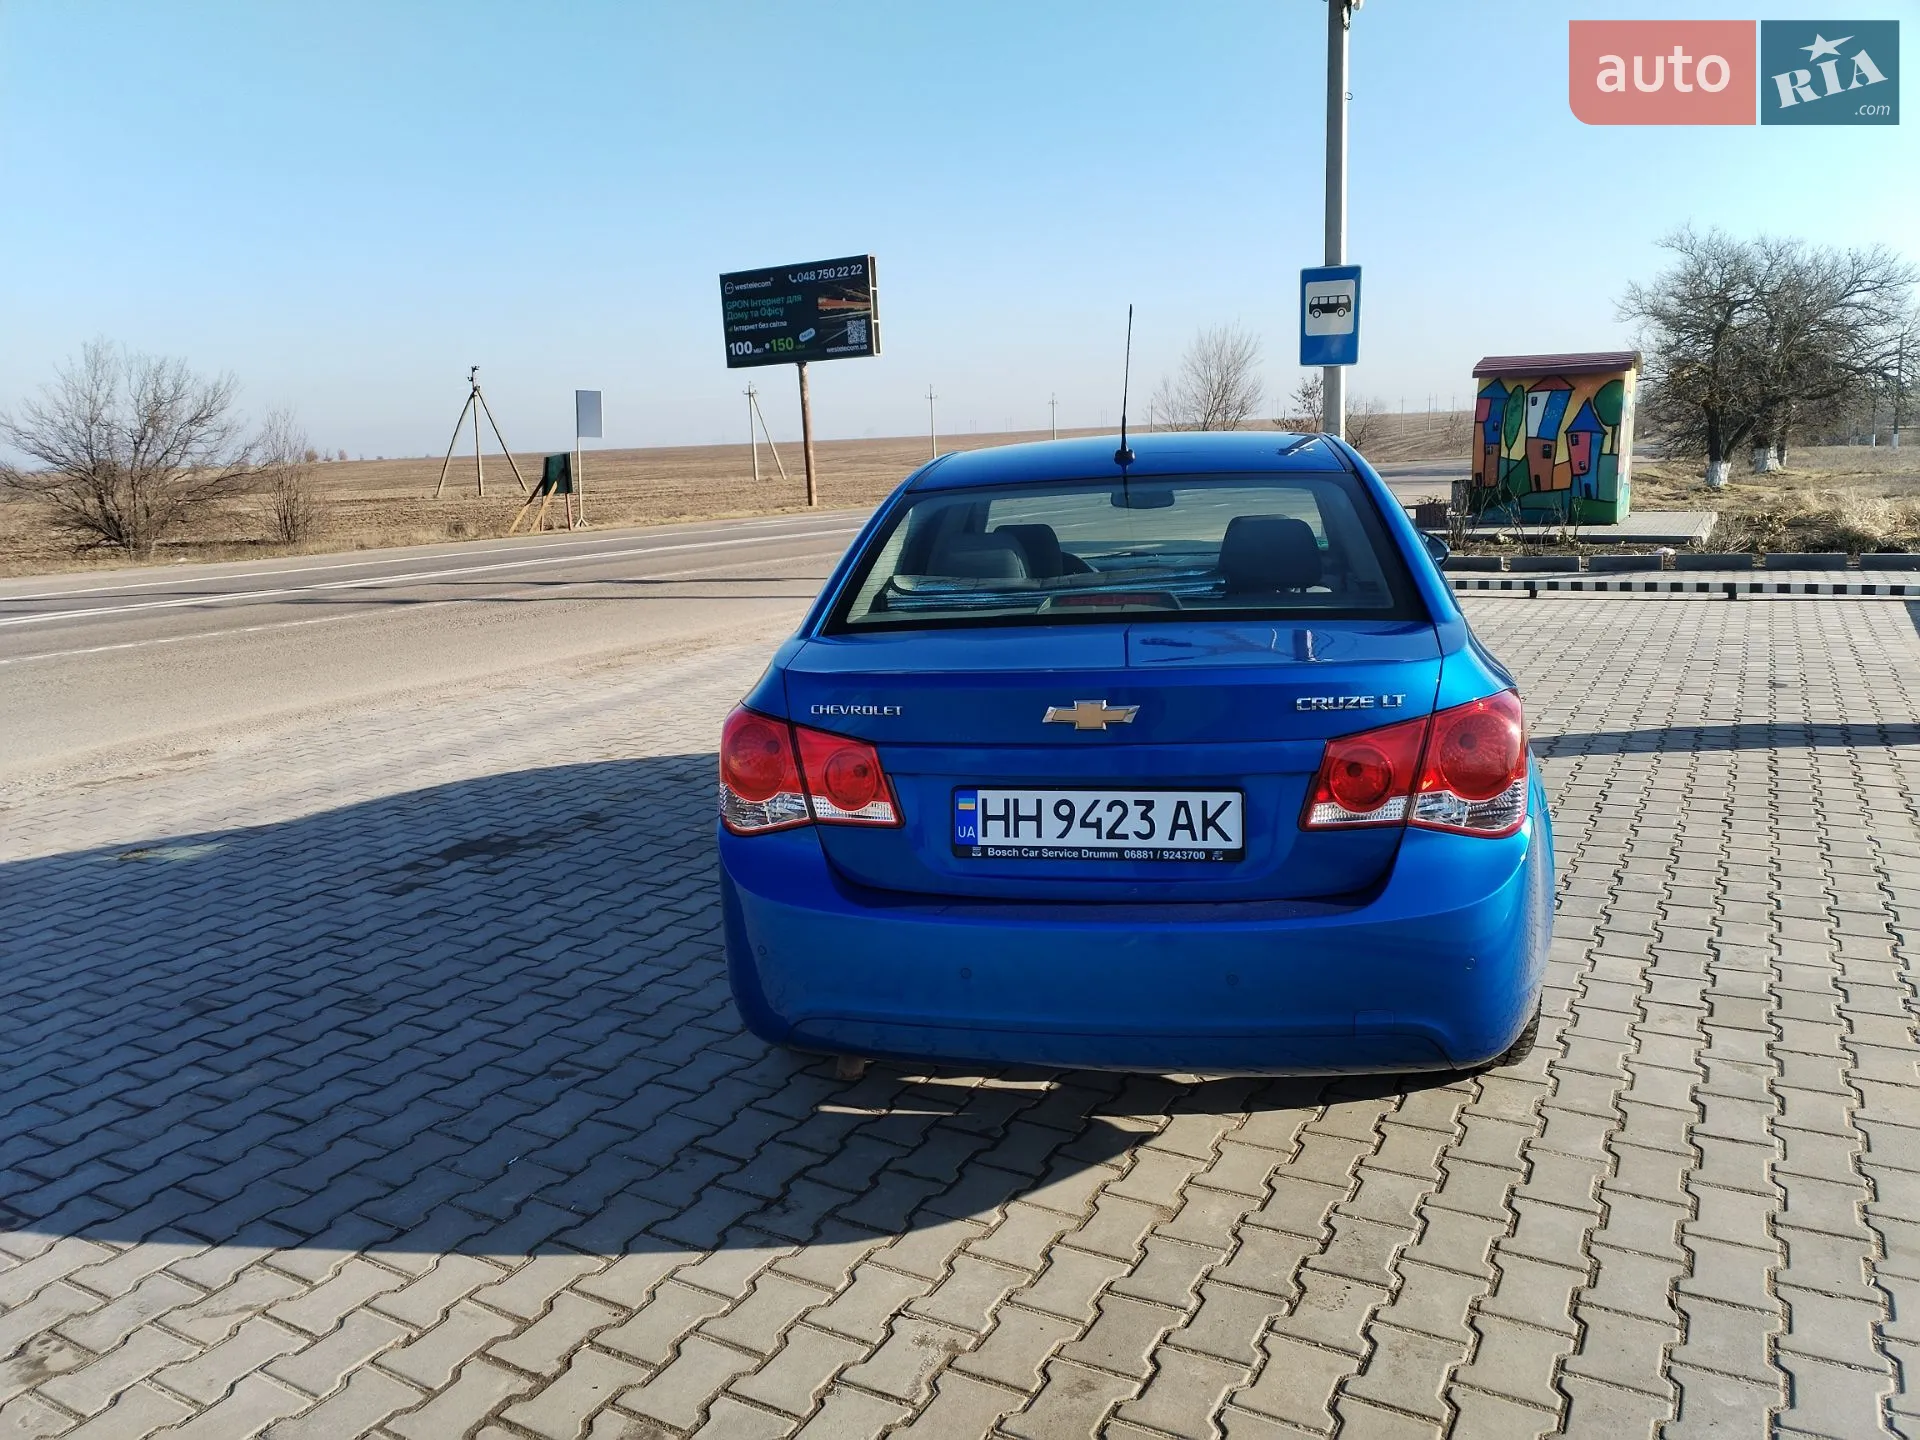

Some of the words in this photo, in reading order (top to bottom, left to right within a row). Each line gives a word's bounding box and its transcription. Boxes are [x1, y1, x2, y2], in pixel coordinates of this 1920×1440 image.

[797, 271, 816, 282] 048
[817, 268, 835, 279] 750
[837, 266, 849, 277] 22
[850, 264, 863, 275] 22
[726, 299, 749, 309] GPON
[751, 297, 784, 307] Інтернет
[727, 311, 749, 320] Дому
[760, 307, 784, 317] Офісу
[758, 321, 769, 329] без
[729, 341, 753, 355] 100
[770, 337, 794, 352] 150
[1296, 695, 1375, 711] CRUZE
[1382, 694, 1406, 708] LT
[810, 704, 903, 716] CHEVROLET
[981, 798, 1042, 838] HH
[1053, 798, 1156, 841] 9423
[1168, 800, 1233, 842] AK
[958, 826, 976, 838] UA
[987, 847, 1019, 857] Bosch
[1021, 848, 1039, 857] Car
[1041, 848, 1079, 858] Service
[1081, 849, 1118, 858] Drumm
[1124, 850, 1154, 859] 06881
[1163, 850, 1206, 860] 9243700
